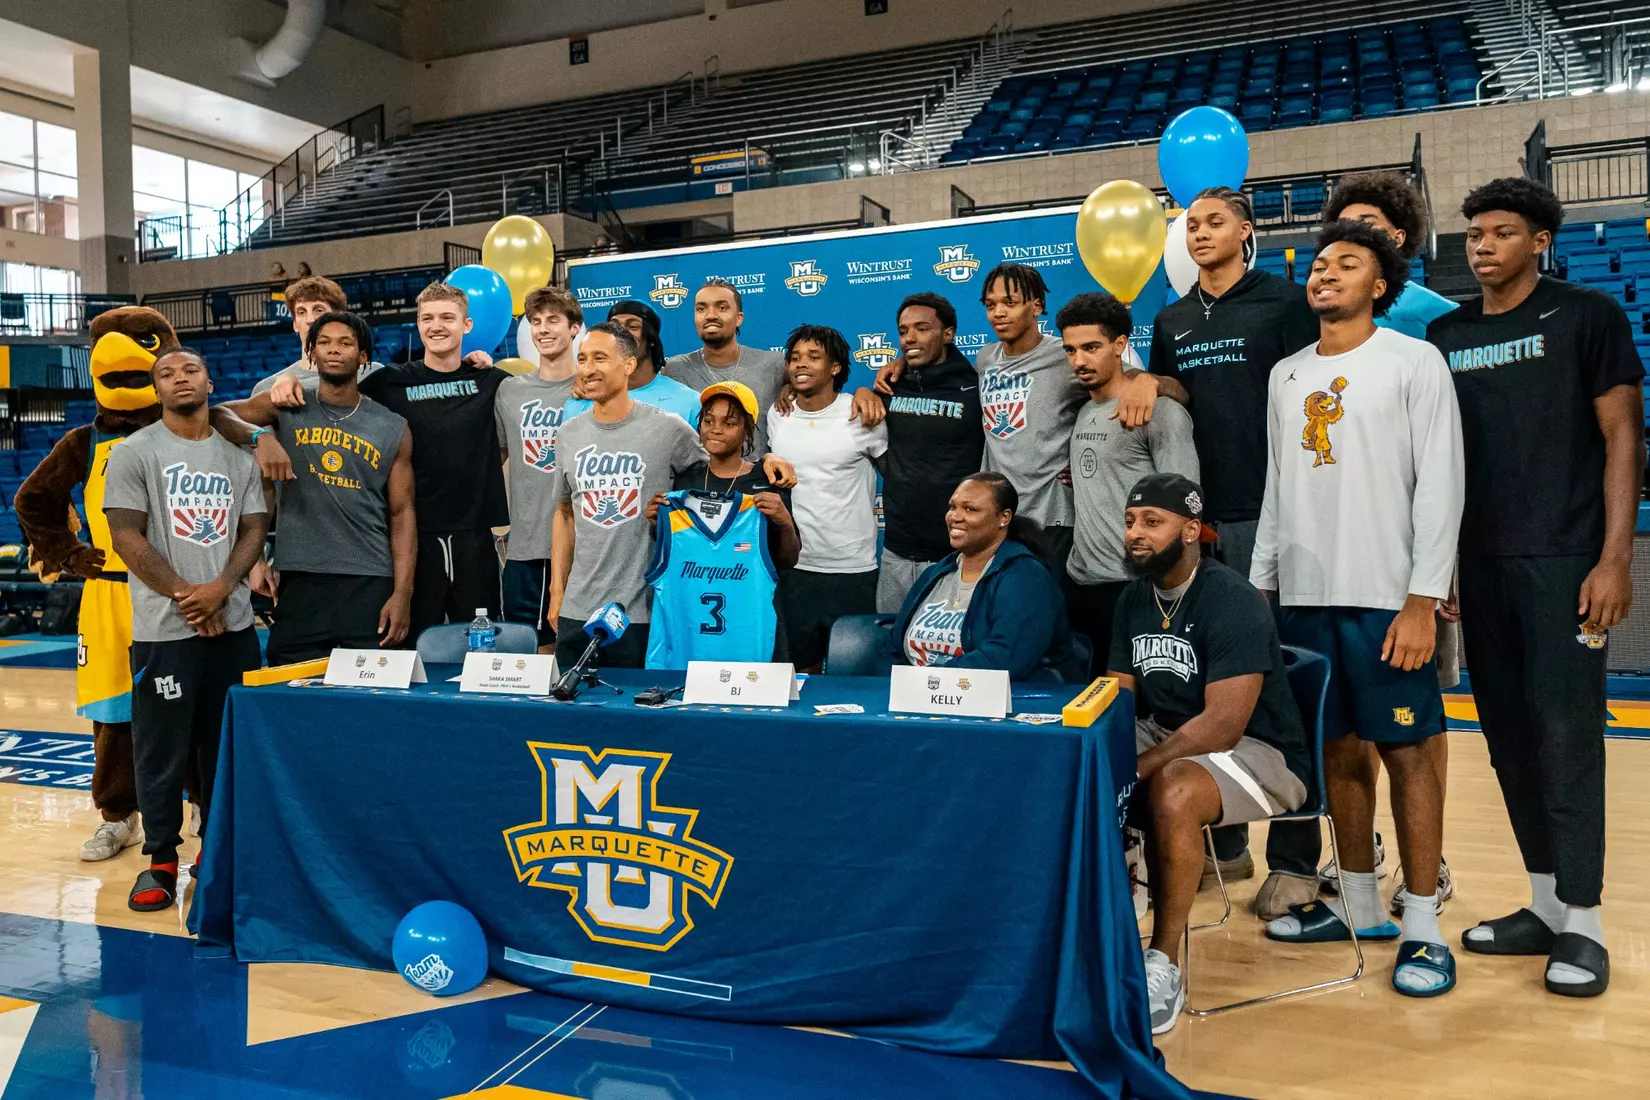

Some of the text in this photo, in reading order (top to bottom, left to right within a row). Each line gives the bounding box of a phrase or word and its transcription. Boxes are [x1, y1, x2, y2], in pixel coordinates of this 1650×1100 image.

[1002, 243, 1073, 258] WINTRUST
[847, 259, 912, 273] WINTRUST
[849, 275, 891, 284] WISCONSIN'S
[577, 286, 632, 298] WINTRUST
[1176, 338, 1245, 357] MARQUETTE
[1449, 334, 1545, 373] MARQUETTE
[1178, 353, 1247, 371] BASKETBALL
[406, 379, 479, 402] MARQUETTE
[889, 396, 965, 419] MARQUETTE
[522, 429, 558, 438] IMPA
[576, 446, 645, 478] Team
[165, 463, 233, 495] Team
[578, 476, 643, 490] IMPACT
[170, 497, 232, 508] IMPACT
[680, 560, 749, 584] Marquette
[700, 592, 726, 635] 3
[909, 628, 955, 644] IMPAC
[359, 670, 376, 679] Erin
[154, 675, 182, 700] MU
[731, 687, 741, 696] BJ
[931, 694, 962, 705] KELLY
[1393, 707, 1414, 725] MU
[543, 750, 685, 941] MU
[527, 835, 708, 878] MARQUETTE
[405, 955, 439, 981] Team
